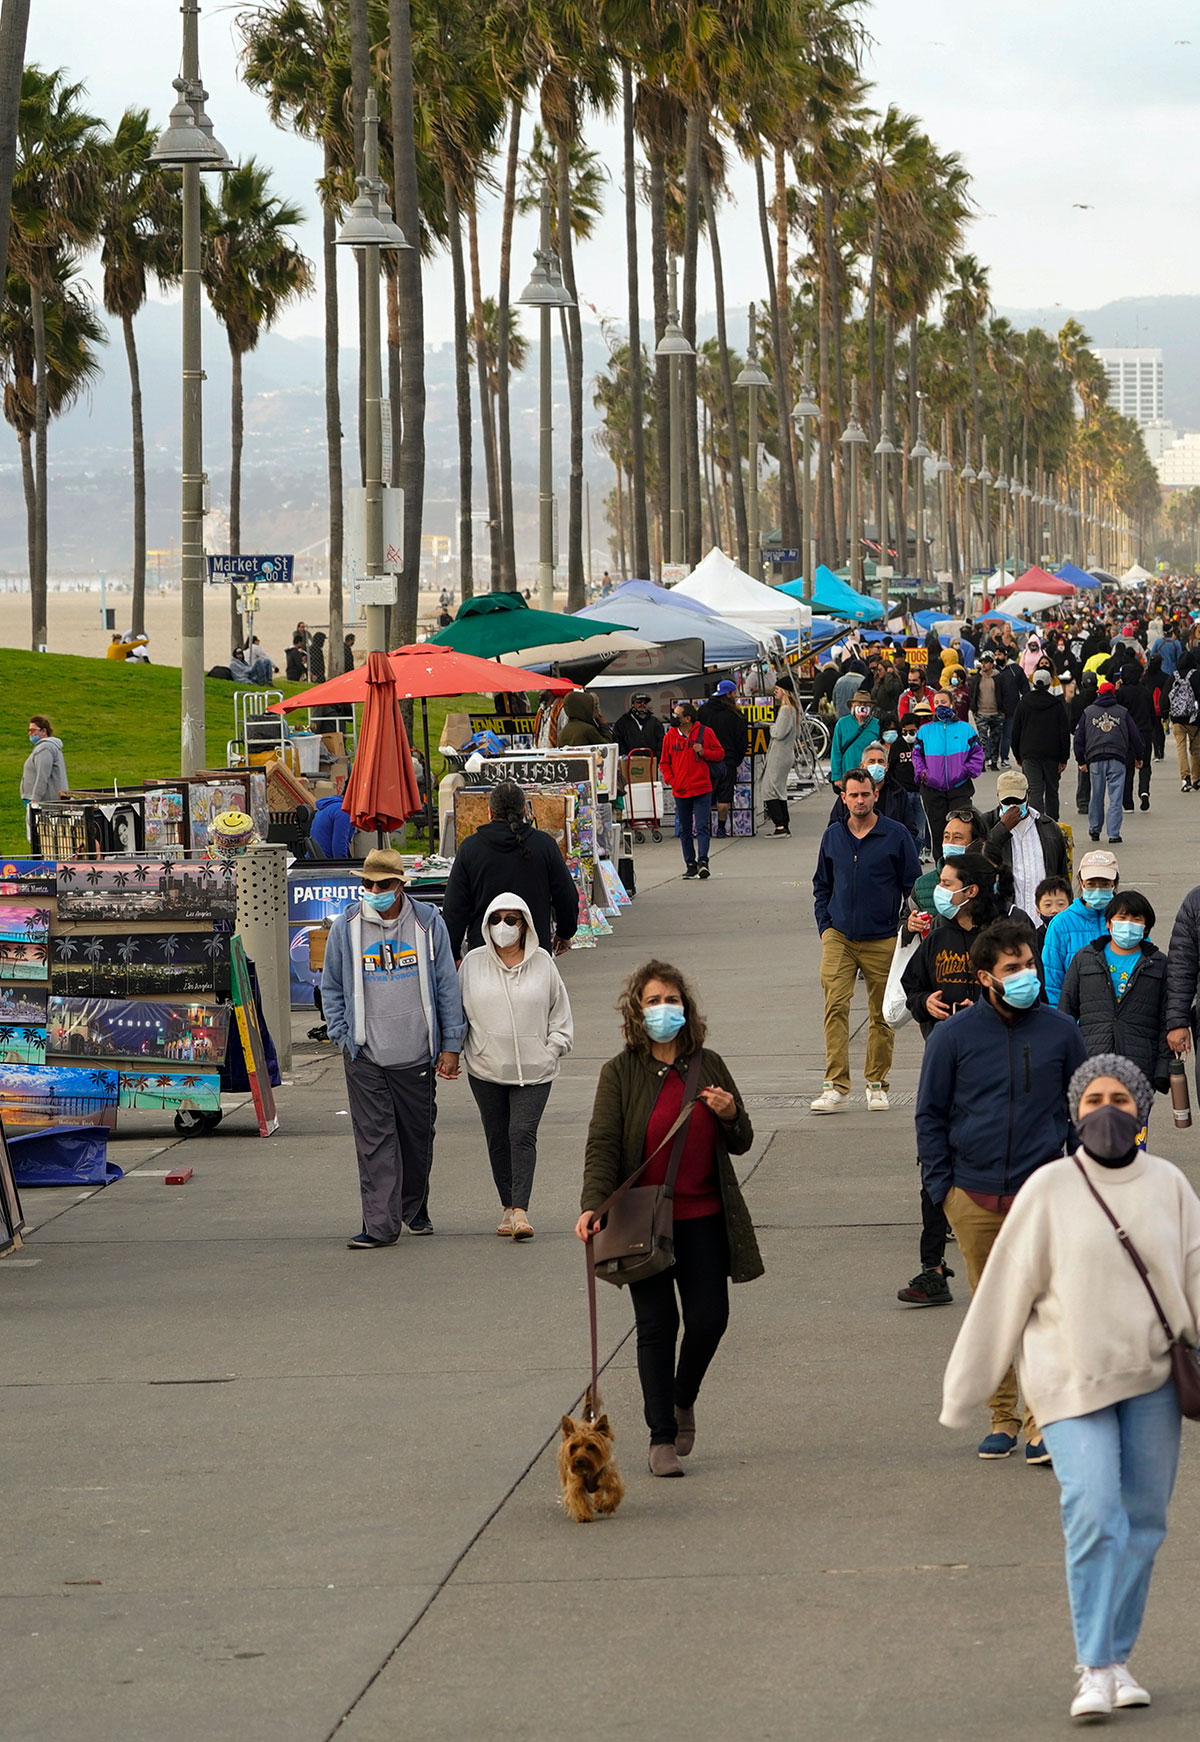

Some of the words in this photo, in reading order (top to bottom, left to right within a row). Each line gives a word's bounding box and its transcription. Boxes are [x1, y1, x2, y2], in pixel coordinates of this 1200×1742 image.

[214, 557, 258, 571] Market
[274, 557, 288, 571] St
[283, 572, 288, 580] E
[512, 719, 535, 733] TAT
[294, 886, 365, 904] PATRIOTS
[109, 1018, 160, 1027] VENICE
